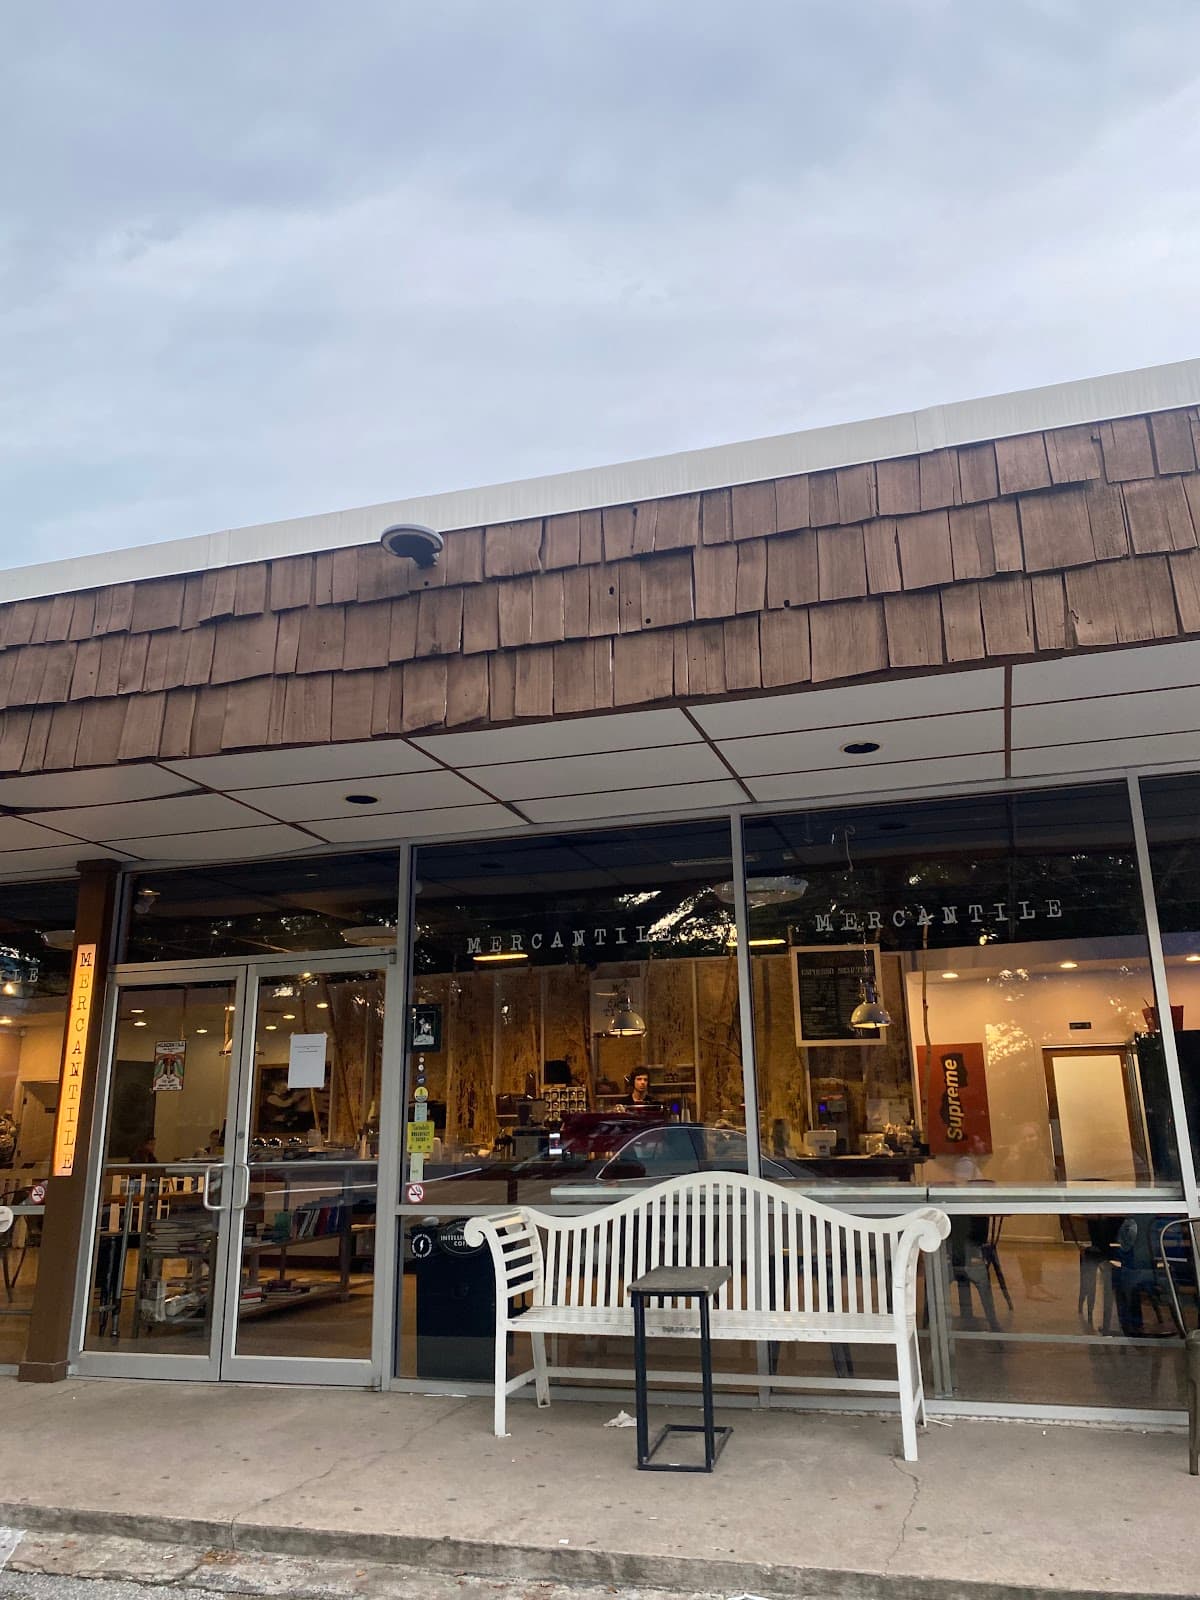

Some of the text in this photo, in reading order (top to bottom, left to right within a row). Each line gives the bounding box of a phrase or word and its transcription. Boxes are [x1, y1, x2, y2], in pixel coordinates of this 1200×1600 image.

[467, 926, 672, 953] MERCANTILE
[816, 899, 1063, 931] MERCANTILE
[61, 952, 92, 1169] MERCANTILE
[945, 1059, 965, 1140] Supreme
